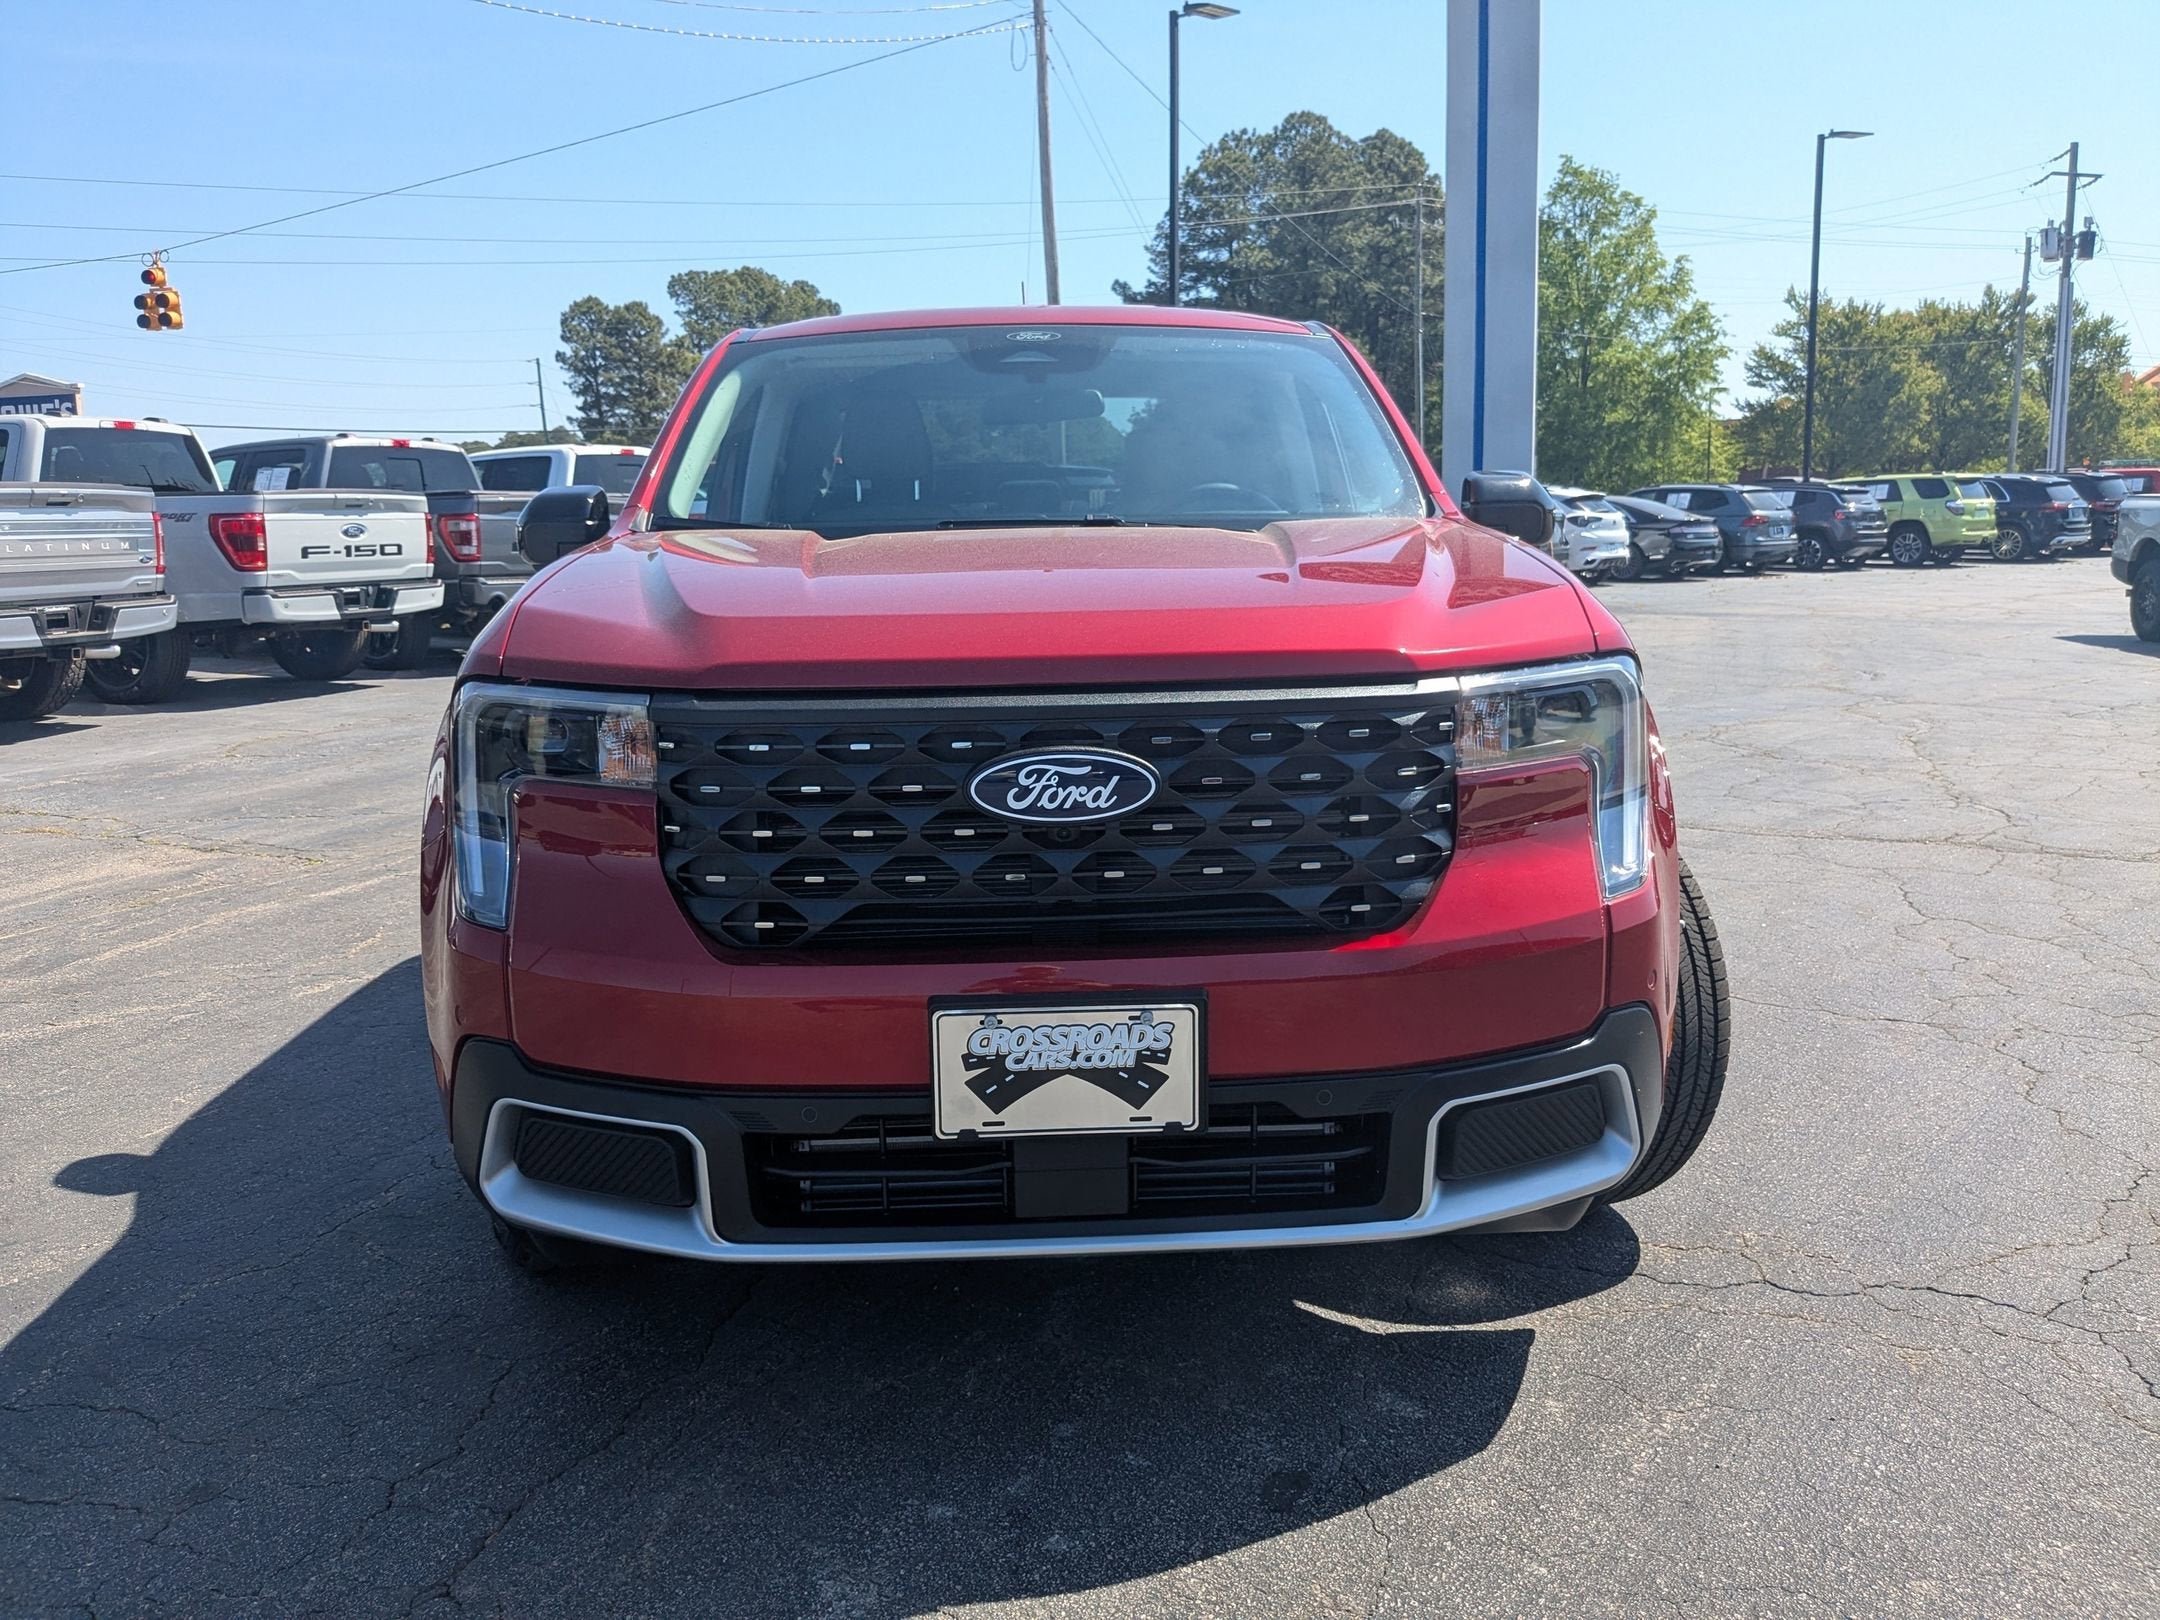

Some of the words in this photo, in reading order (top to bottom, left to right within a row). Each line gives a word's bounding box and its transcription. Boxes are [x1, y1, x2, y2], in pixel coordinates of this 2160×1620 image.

[0, 399, 73, 417] OWE'S
[5, 541, 130, 553] LATINUM
[300, 543, 403, 559] F-150
[1006, 764, 1121, 810] Ford
[968, 1022, 1175, 1056] CROSSROADS
[1004, 1049, 1138, 1072] CARS.COM
